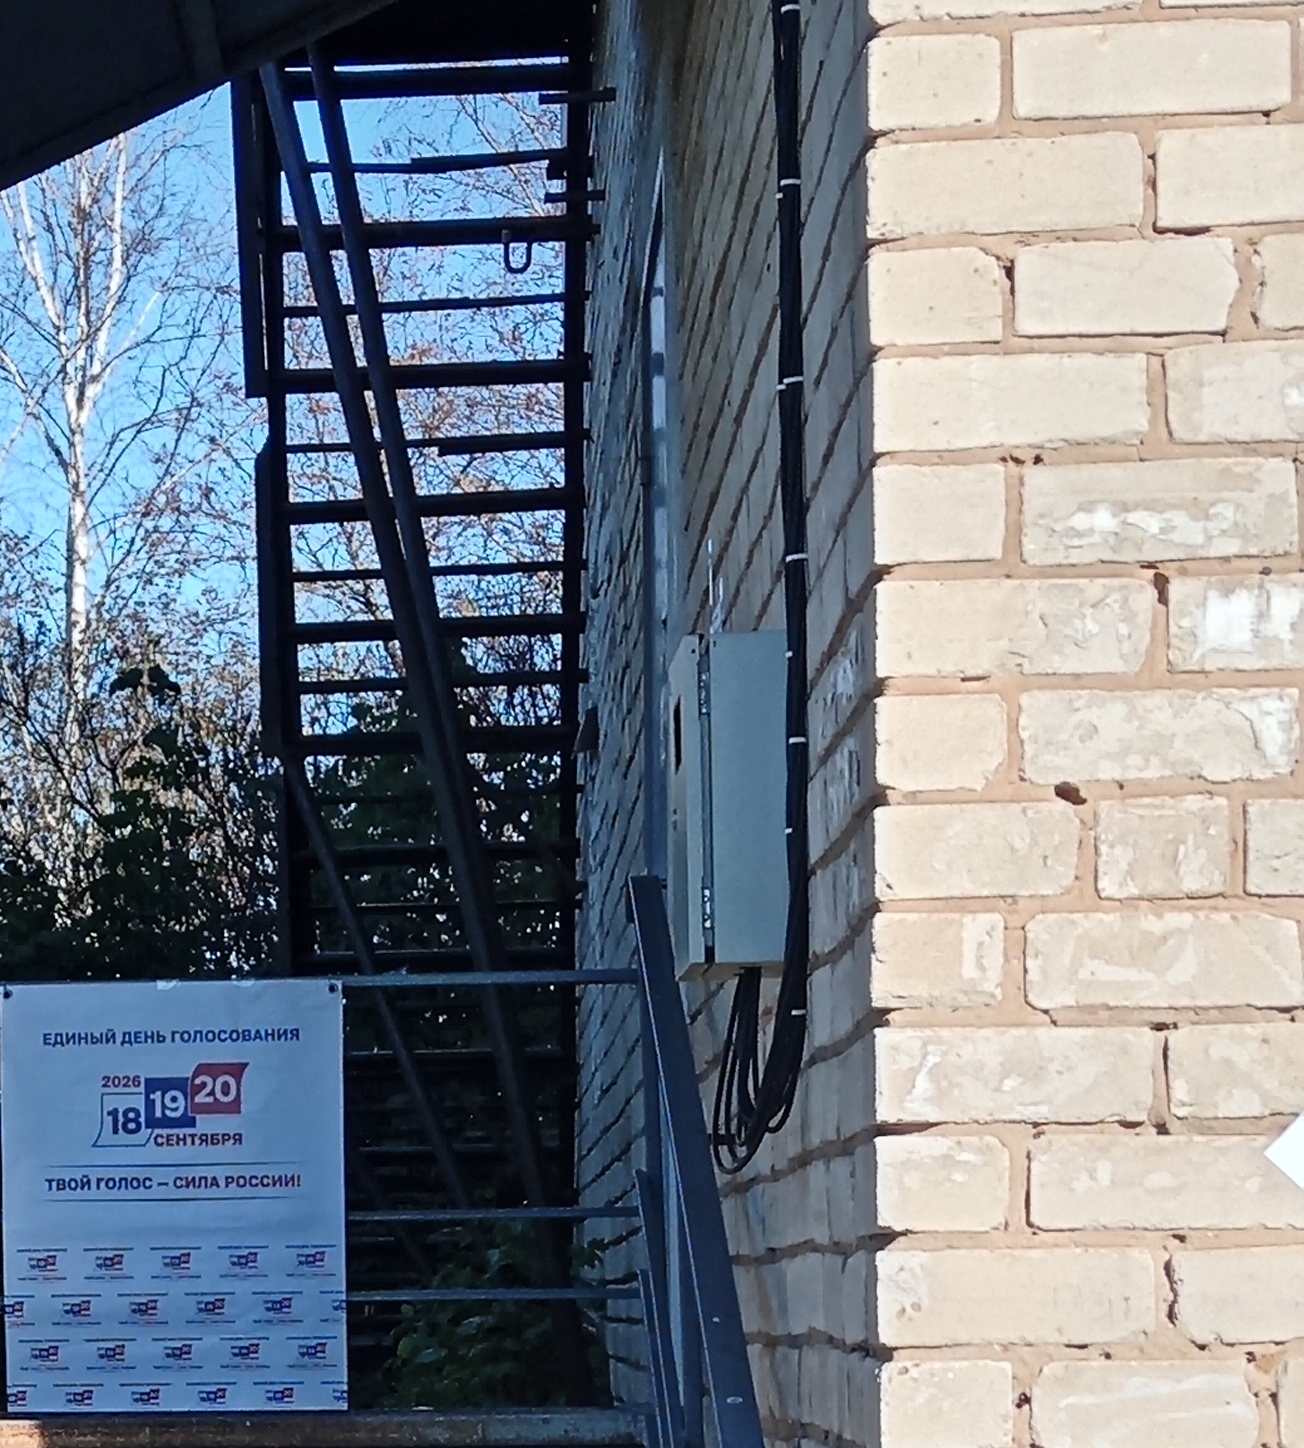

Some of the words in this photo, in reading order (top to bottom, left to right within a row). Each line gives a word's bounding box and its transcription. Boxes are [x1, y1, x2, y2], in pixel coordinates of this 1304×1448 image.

[42, 1028, 117, 1048] ЕДИНЫЙ
[120, 1030, 167, 1047] ДЕНЬ
[170, 1027, 301, 1044] ГОЛОСОВАНИЯ
[101, 1075, 142, 1089] 2026
[106, 1106, 143, 1135] 18
[149, 1089, 186, 1119] 19
[193, 1074, 237, 1103] 20
[153, 1132, 244, 1148] СЕНТЯБРЯ
[44, 1174, 92, 1192] ТВОЙ
[96, 1176, 154, 1192] ГОЛОС
[173, 1174, 220, 1190] СИЛА
[224, 1173, 302, 1190] РОССИИ!
